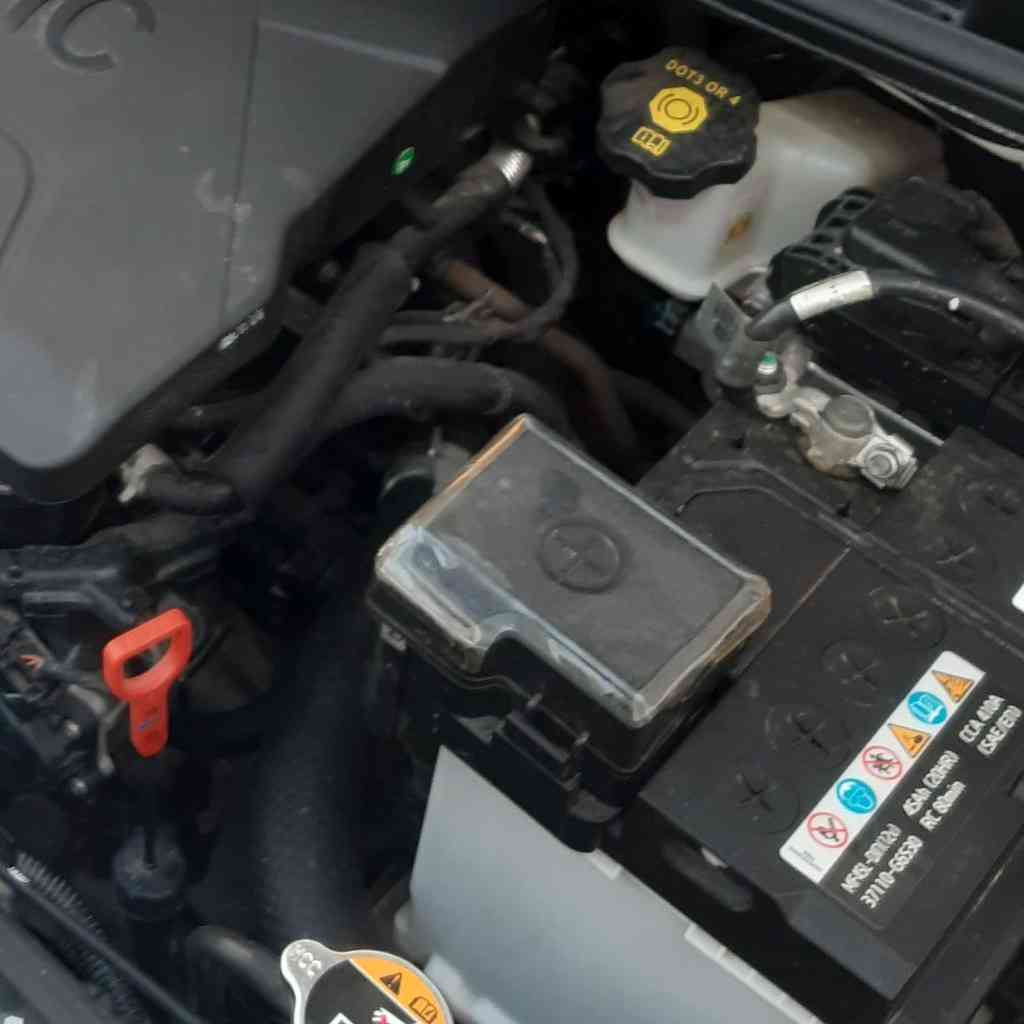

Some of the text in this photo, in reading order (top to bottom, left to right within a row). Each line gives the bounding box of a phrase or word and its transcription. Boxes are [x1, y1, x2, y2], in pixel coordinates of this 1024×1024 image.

[665, 59, 704, 85] DOT3
[706, 81, 728, 98] OR
[959, 719, 986, 743] CCA
[919, 809, 942, 831] RC
